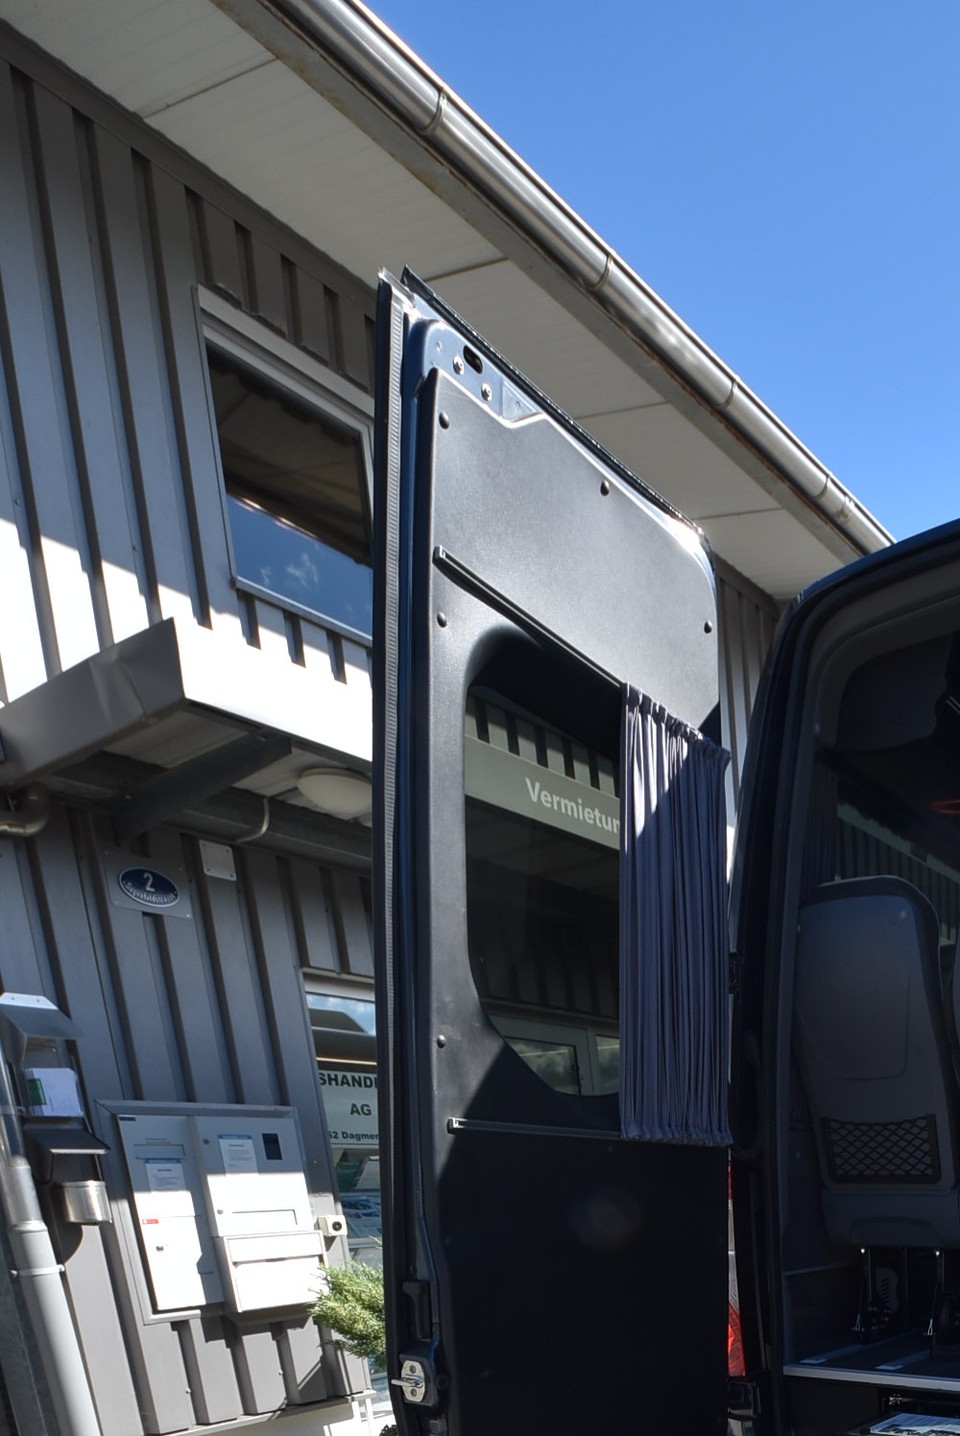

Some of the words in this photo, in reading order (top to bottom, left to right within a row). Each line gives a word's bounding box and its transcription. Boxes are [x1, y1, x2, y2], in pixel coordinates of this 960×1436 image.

[144, 872, 156, 892] 2
[319, 1072, 378, 1089] SHAND
[350, 1103, 372, 1116] AG
